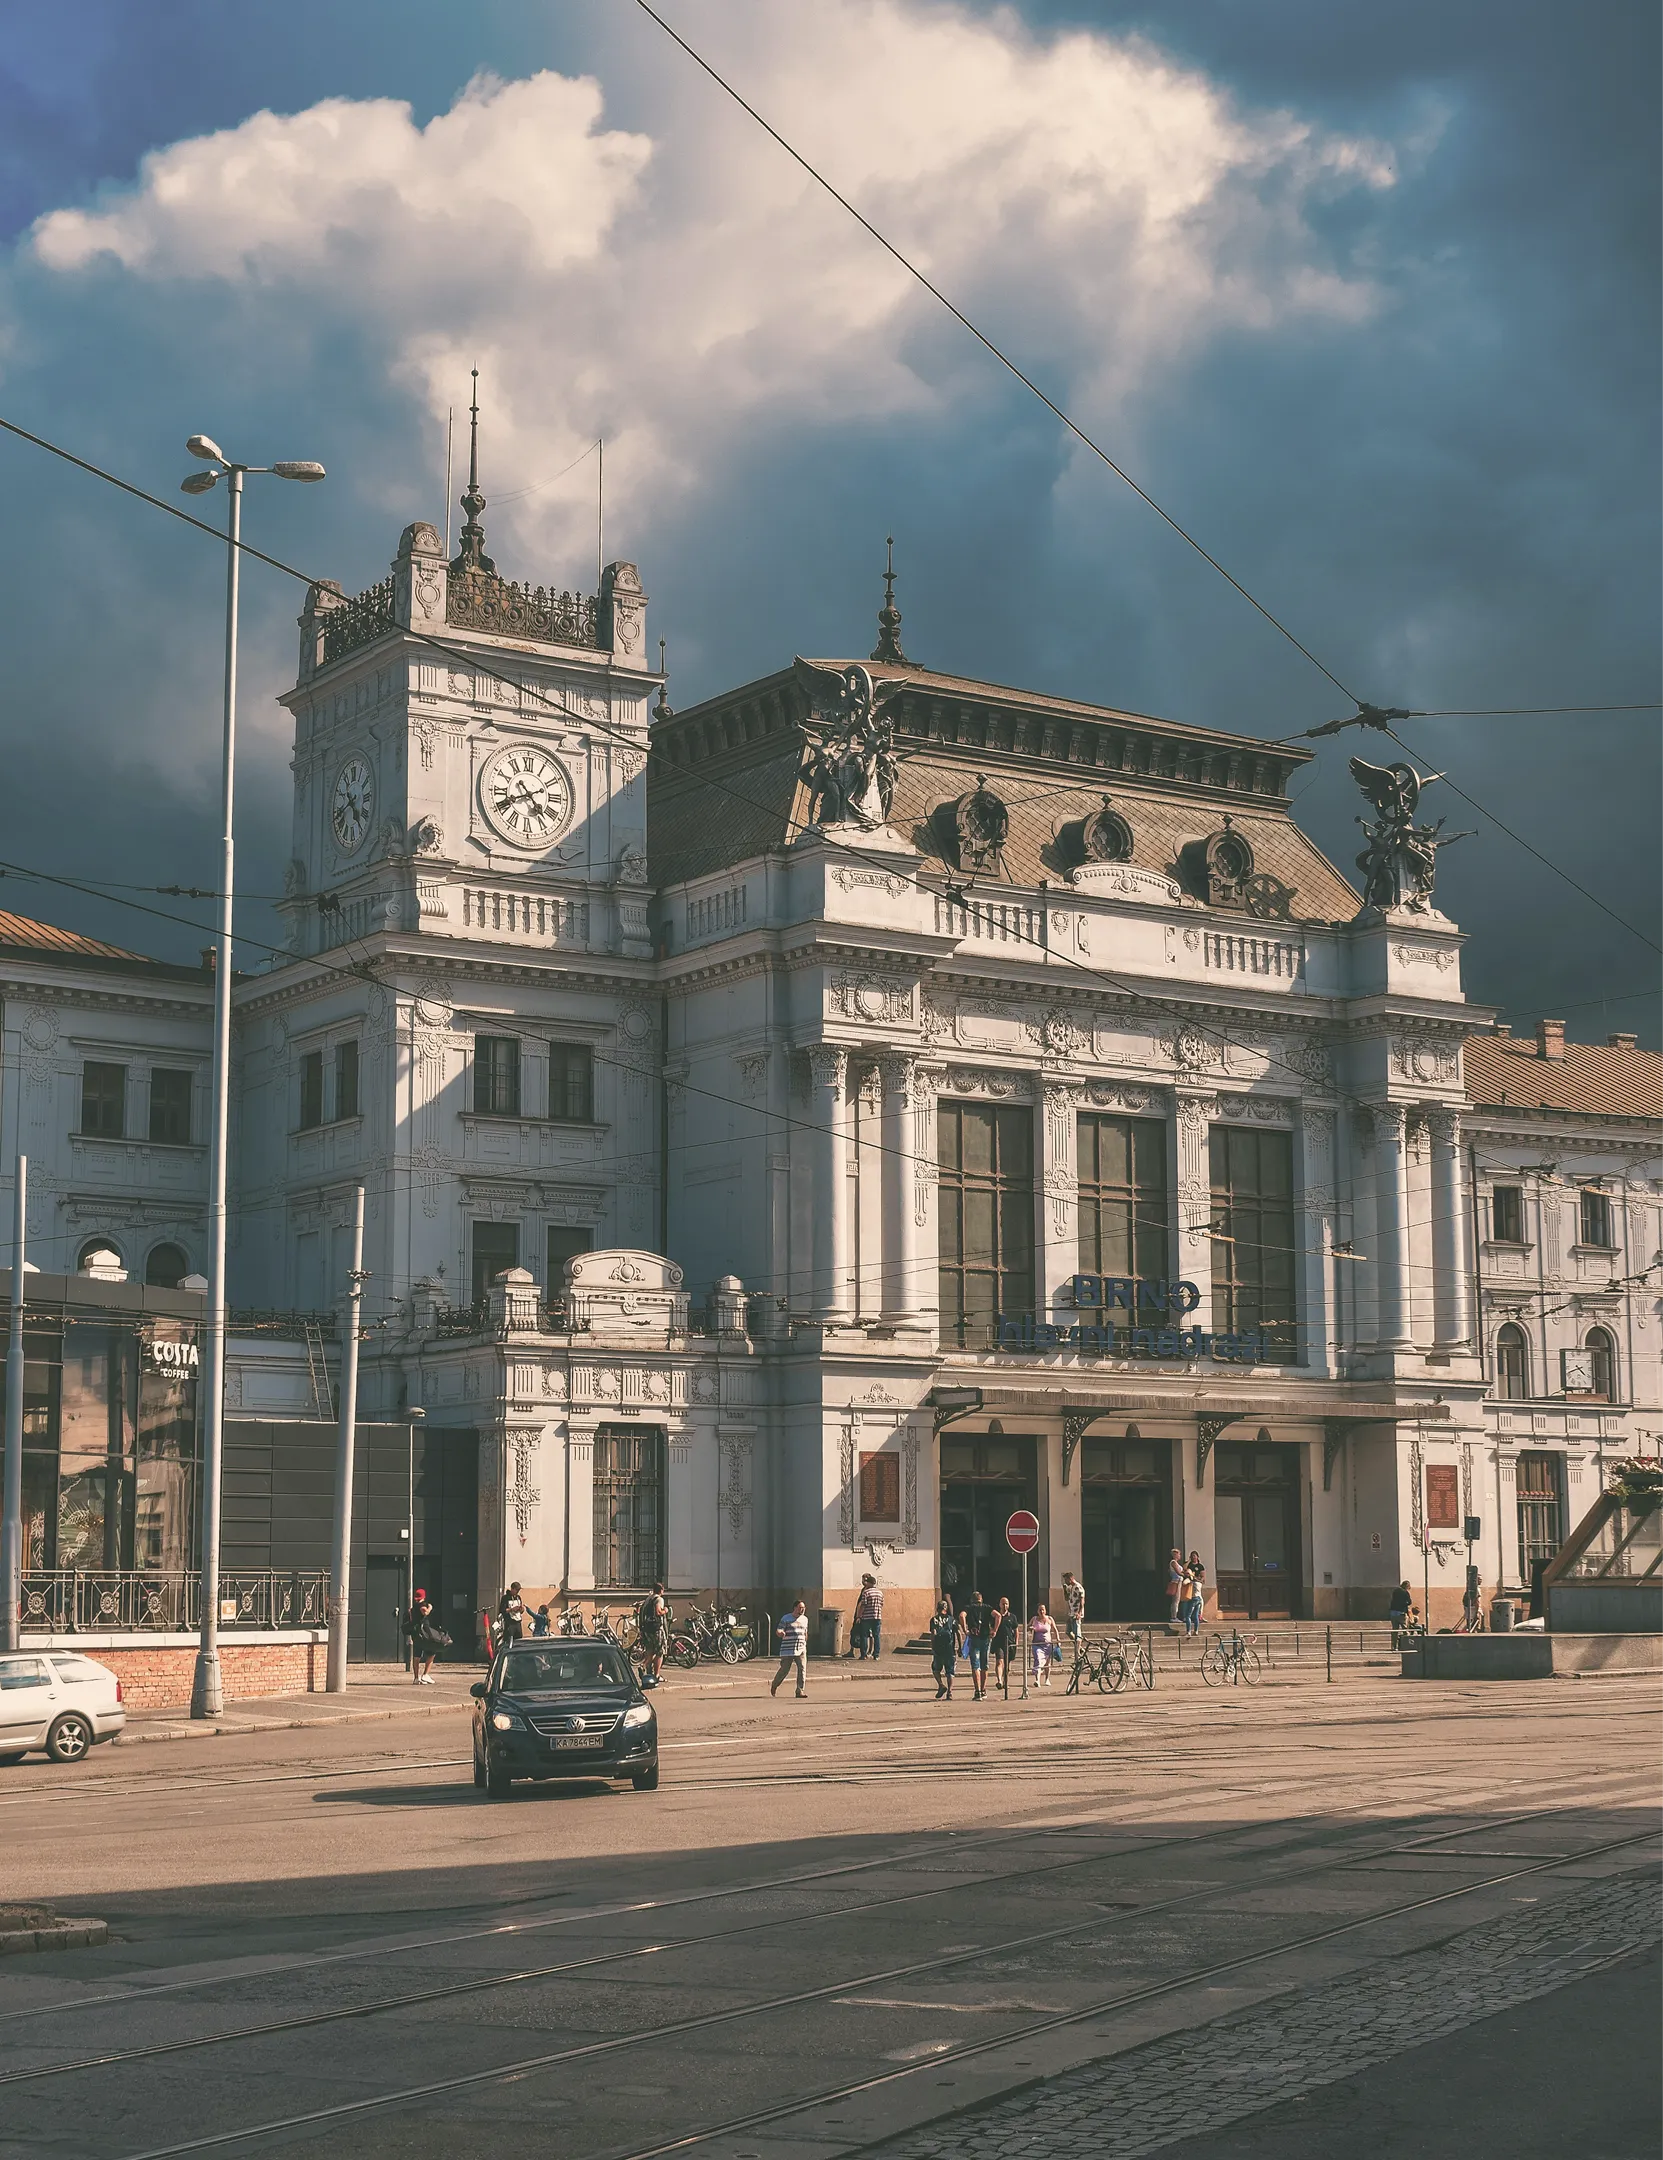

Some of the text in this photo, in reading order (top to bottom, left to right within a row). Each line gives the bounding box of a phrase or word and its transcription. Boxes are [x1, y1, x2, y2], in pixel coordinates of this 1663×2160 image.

[508, 758, 521, 775] XI
[522, 757, 534, 773] XII
[497, 769, 512, 783] X
[544, 777, 559, 788] II
[548, 793, 562, 804] III
[1073, 1274, 1201, 1313] BRNO
[152, 1340, 199, 1366] COSTA
[160, 1367, 189, 1379] COFFEE
